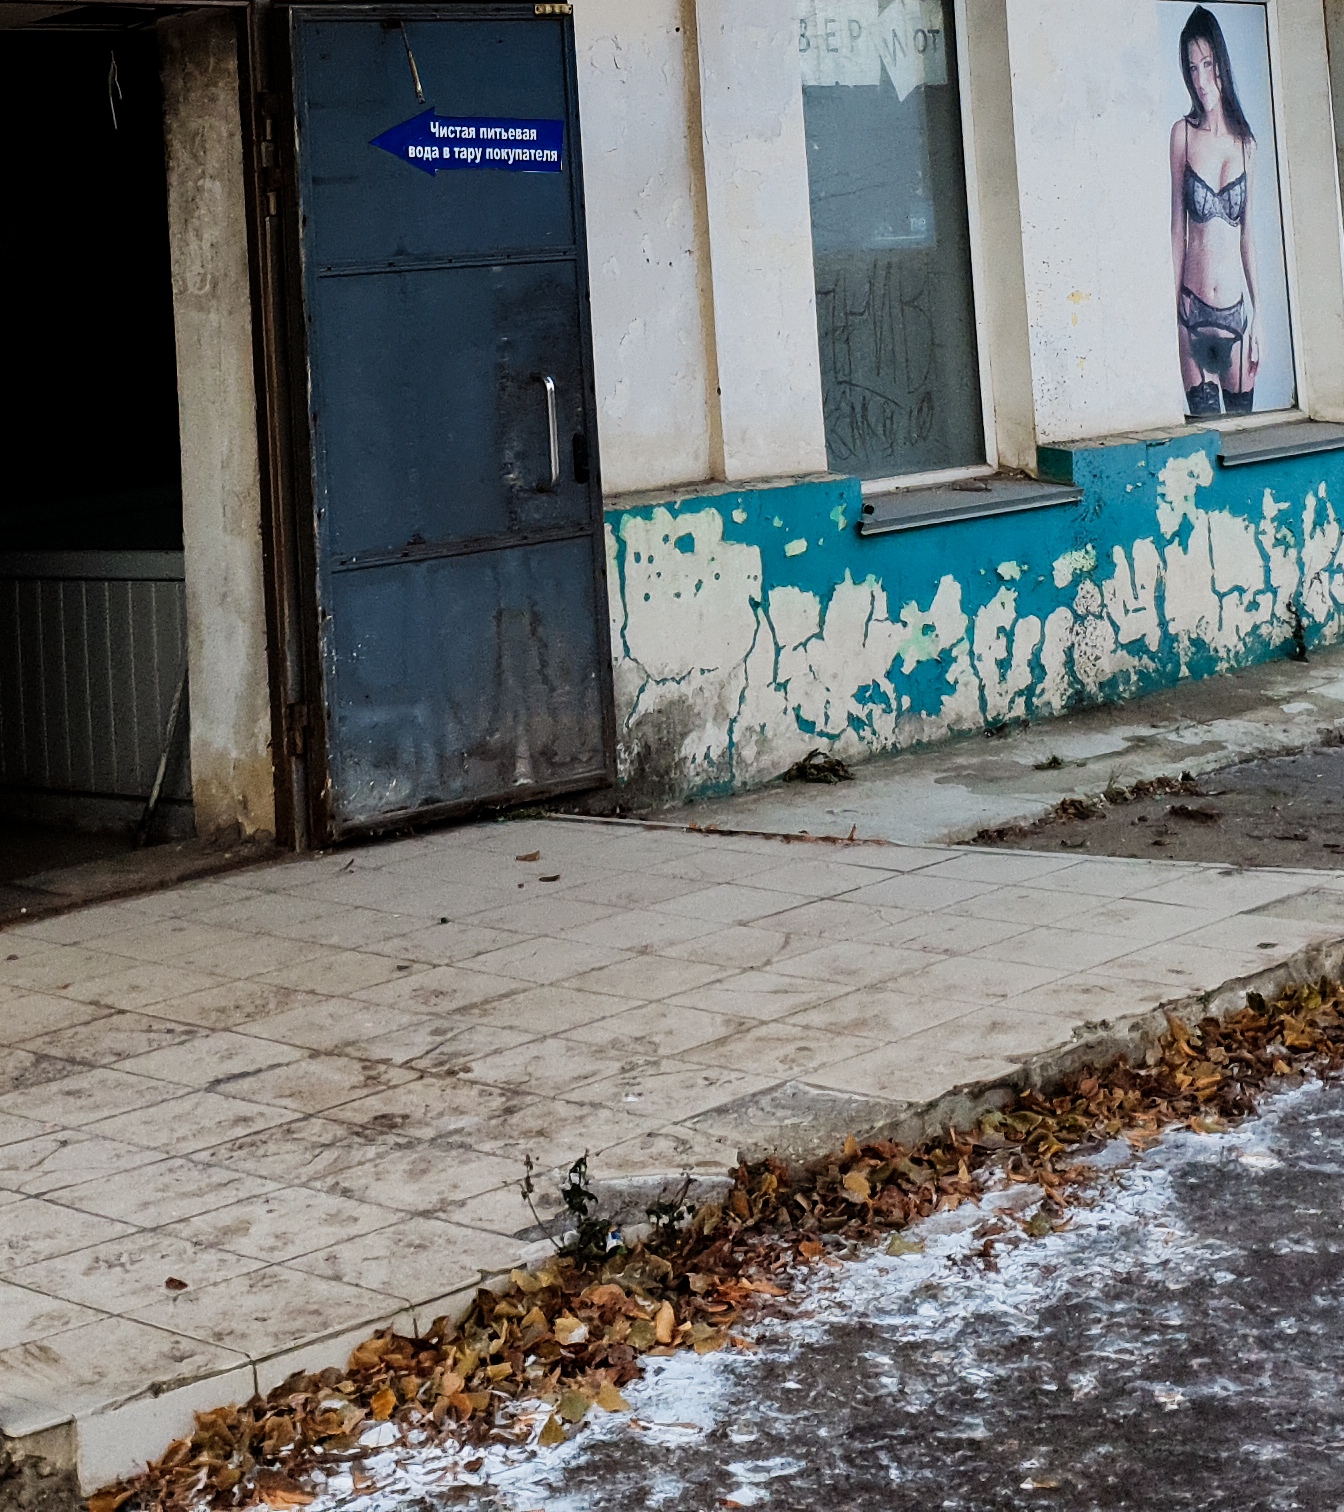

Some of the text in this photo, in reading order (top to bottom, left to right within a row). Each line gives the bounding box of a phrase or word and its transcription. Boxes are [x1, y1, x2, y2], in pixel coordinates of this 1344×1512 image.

[430, 121, 537, 141] Чистая питьевая
[408, 145, 558, 164] вода в тару покупателя
